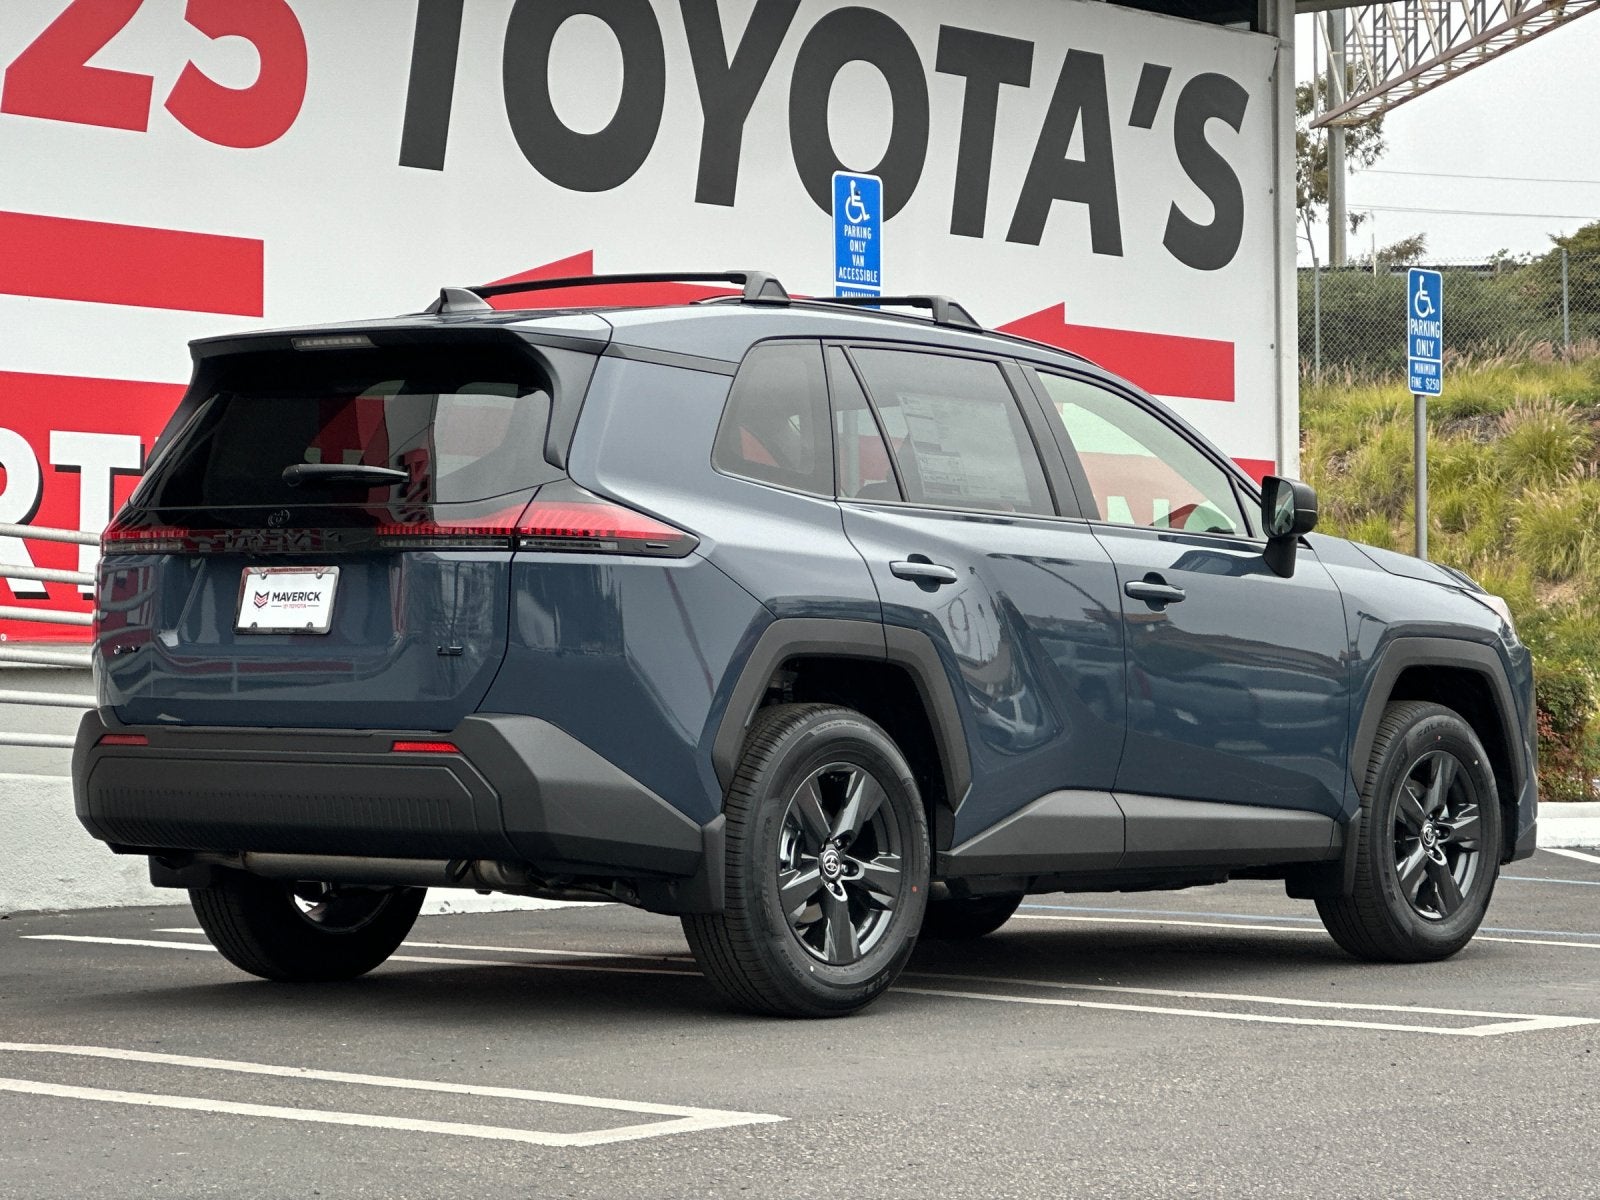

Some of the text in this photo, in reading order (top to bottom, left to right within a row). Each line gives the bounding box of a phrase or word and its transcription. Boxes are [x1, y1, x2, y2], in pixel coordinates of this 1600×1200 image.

[844, 224, 872, 240] PARKING
[849, 240, 866, 253] ONLY
[852, 255, 865, 267] VAN
[838, 266, 878, 282] ACCESSIBLE
[1410, 319, 1440, 338] PARKING
[1416, 339, 1434, 357] ONLY
[1414, 362, 1436, 375] MINIMUM
[1411, 376, 1440, 391] FINE $250
[272, 591, 322, 602] MAVERICK
